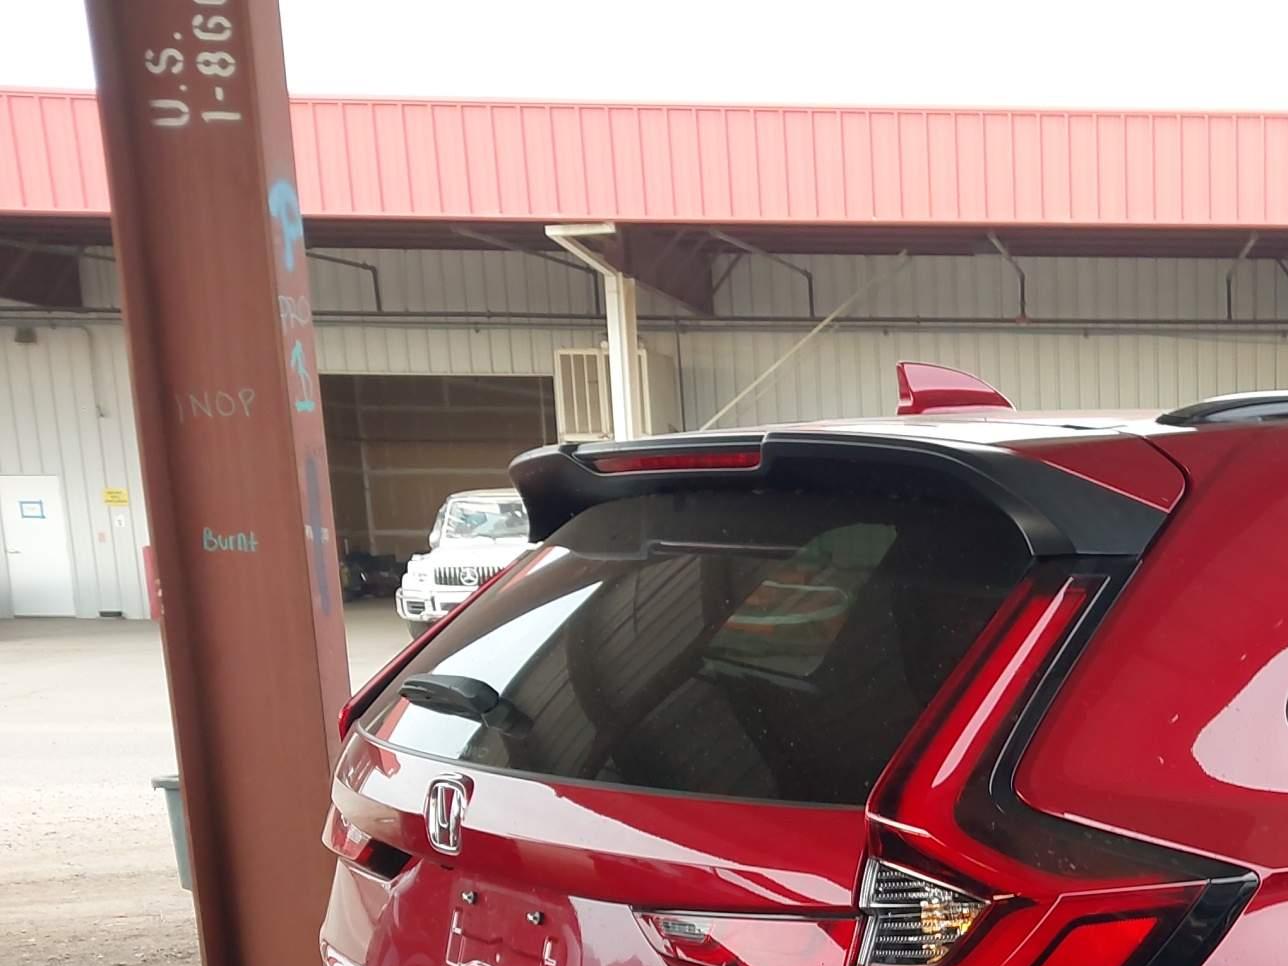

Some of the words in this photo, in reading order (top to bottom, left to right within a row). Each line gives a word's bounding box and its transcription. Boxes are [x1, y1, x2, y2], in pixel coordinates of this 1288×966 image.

[144, 32, 190, 126] U.S.
[192, 0, 242, 123] 1-86
[202, 526, 259, 552] Burnt
